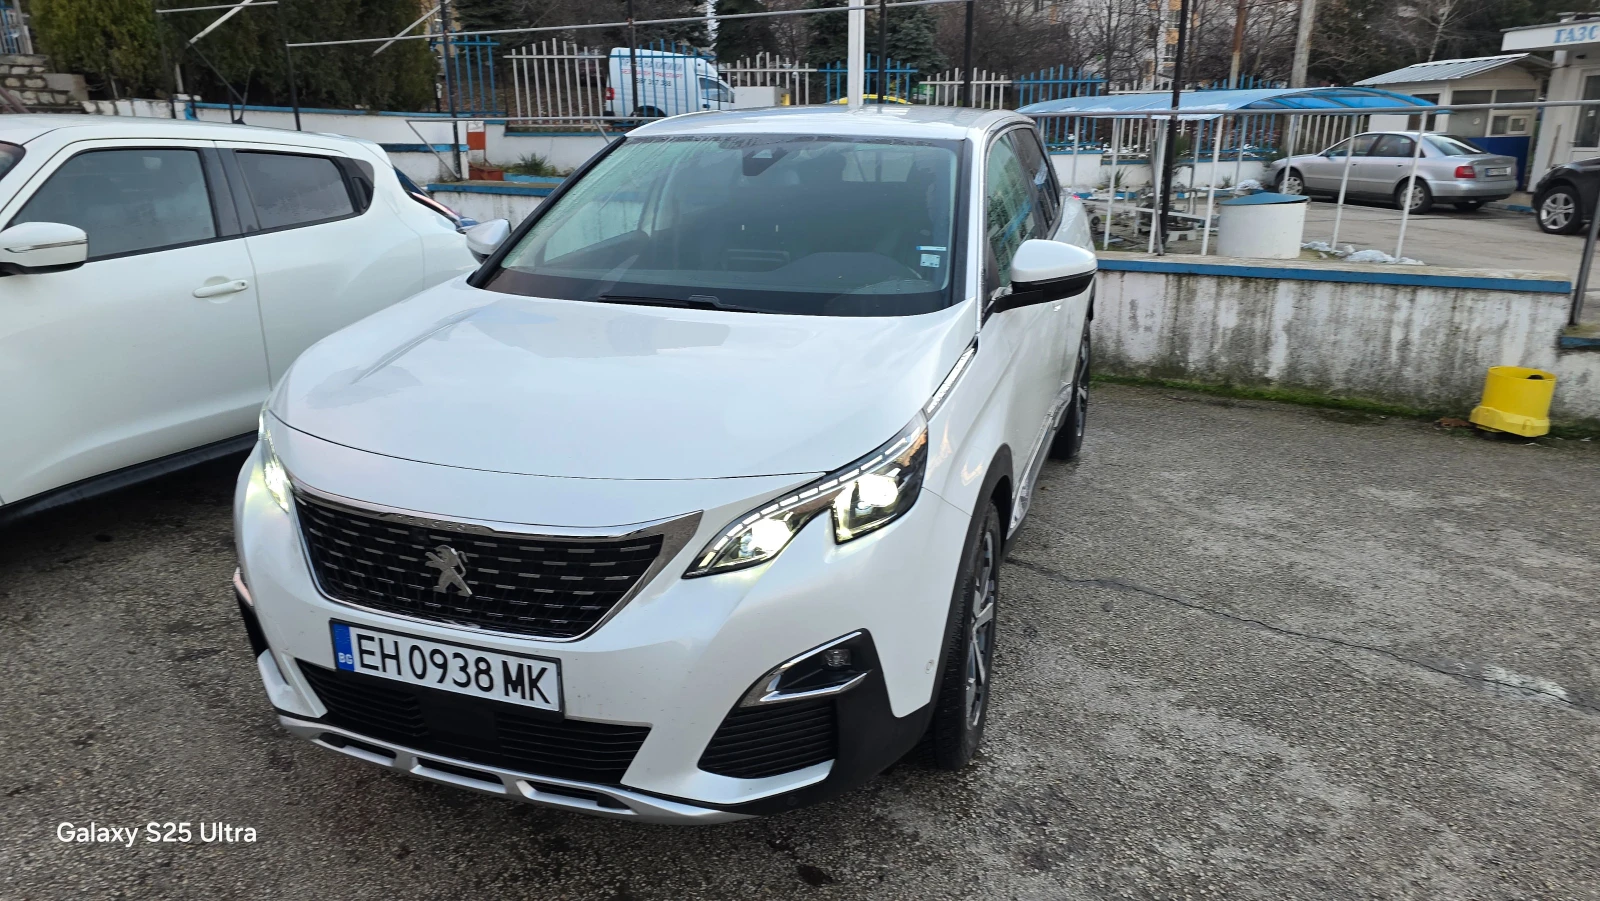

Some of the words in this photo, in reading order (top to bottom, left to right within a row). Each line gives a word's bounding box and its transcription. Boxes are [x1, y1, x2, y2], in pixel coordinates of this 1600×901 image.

[1553, 25, 1600, 43] ГАЗС
[338, 652, 353, 665] BG
[356, 633, 402, 676] EH
[408, 644, 495, 692] 0938
[501, 660, 552, 704] MK
